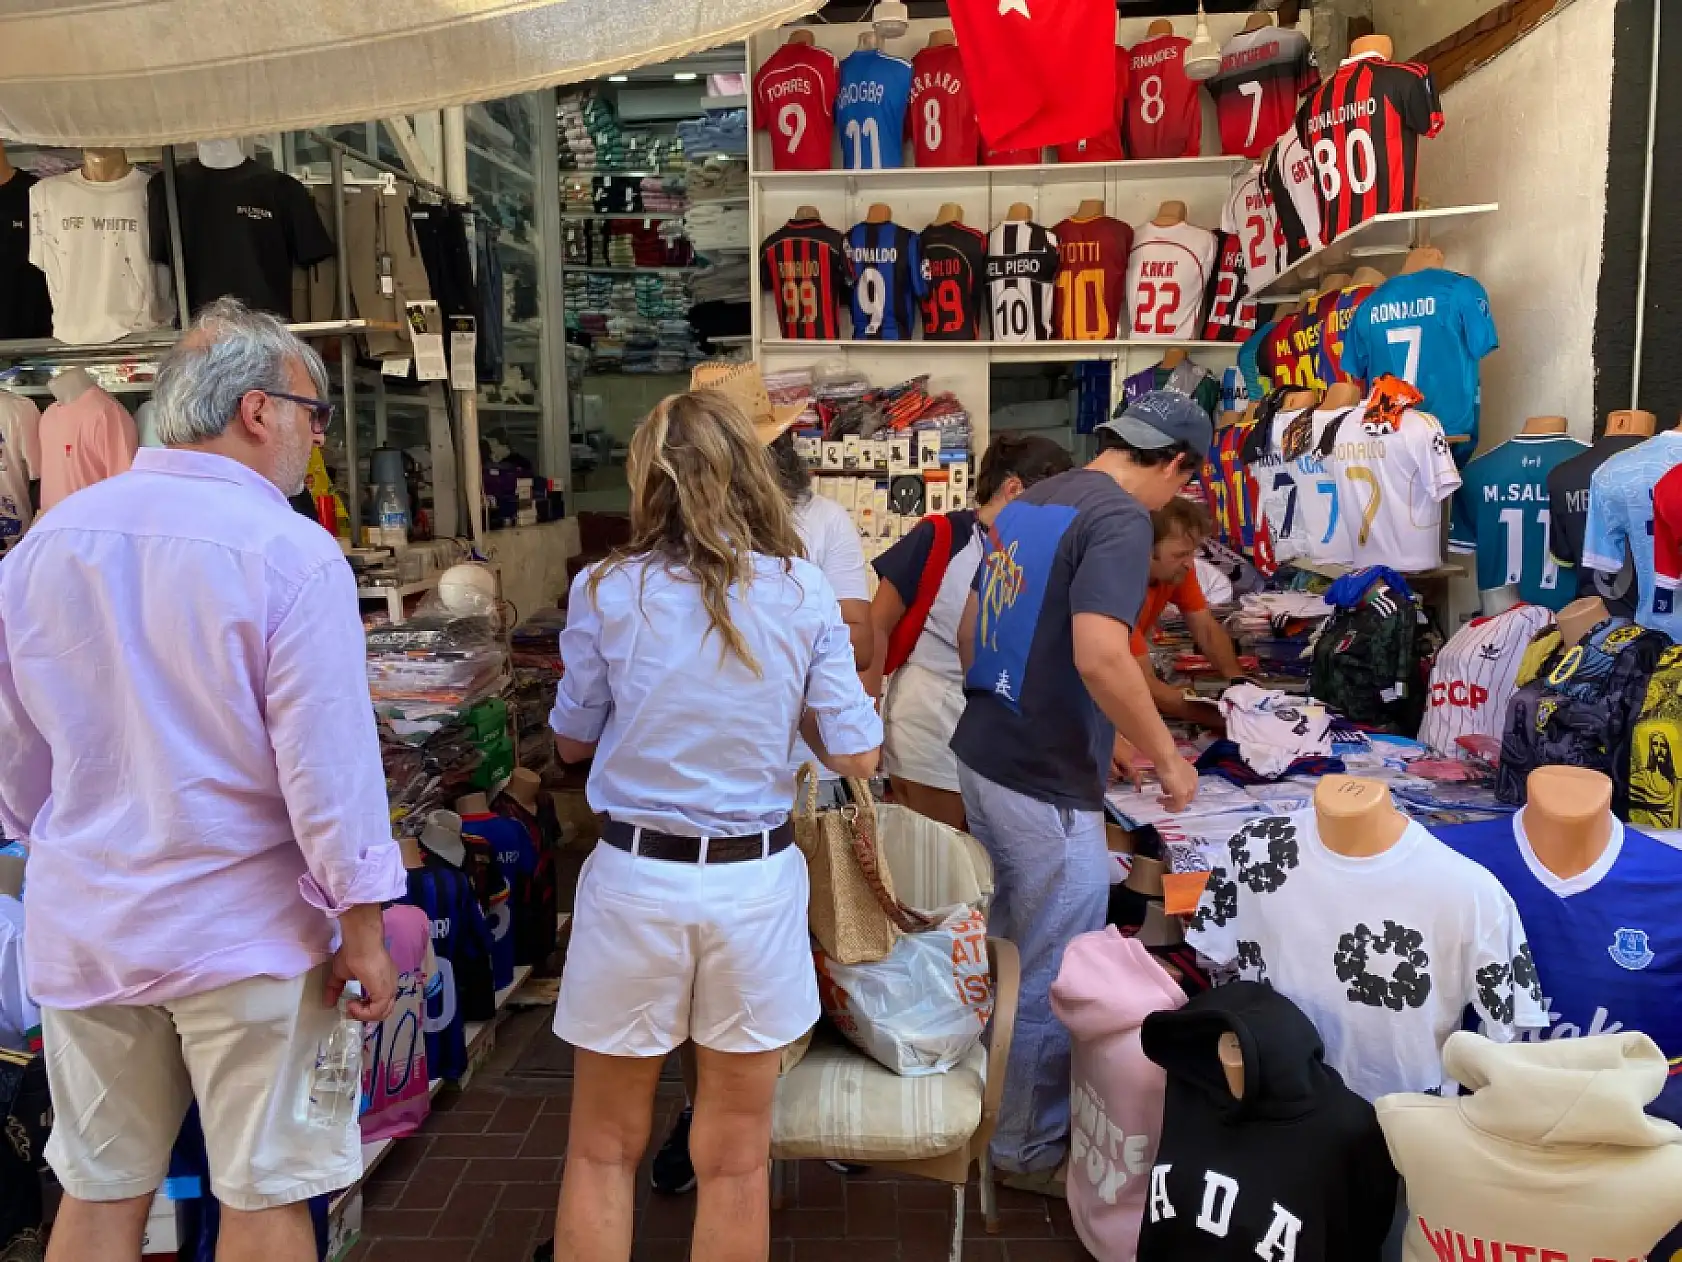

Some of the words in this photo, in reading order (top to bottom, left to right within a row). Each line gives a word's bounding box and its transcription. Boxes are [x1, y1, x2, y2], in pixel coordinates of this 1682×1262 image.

[767, 78, 812, 102] TORRES
[909, 71, 961, 103] ERRARD
[1140, 75, 1165, 124] 8
[778, 102, 807, 154] 9
[923, 98, 942, 151] 8
[1238, 80, 1263, 148] 7
[1308, 97, 1376, 135] RONALDINHO
[845, 117, 882, 169] 11
[1313, 128, 1377, 202] 80
[91, 216, 138, 232] WHITE
[988, 261, 1003, 277] EL
[1005, 258, 1041, 274] PIERO
[1059, 242, 1100, 264] TOTTI
[782, 280, 818, 323] 99
[857, 266, 886, 334] 9
[996, 299, 1028, 336] 10
[1055, 268, 1110, 340] 10
[1134, 281, 1181, 334] 22
[1370, 296, 1436, 324] RONALDO
[1386, 325, 1422, 387] 7
[1272, 472, 1297, 540] 7
[1315, 480, 1340, 544] 7
[1345, 466, 1382, 547] 7
[1483, 484, 1550, 502] M.SAL
[1498, 507, 1559, 590] 11
